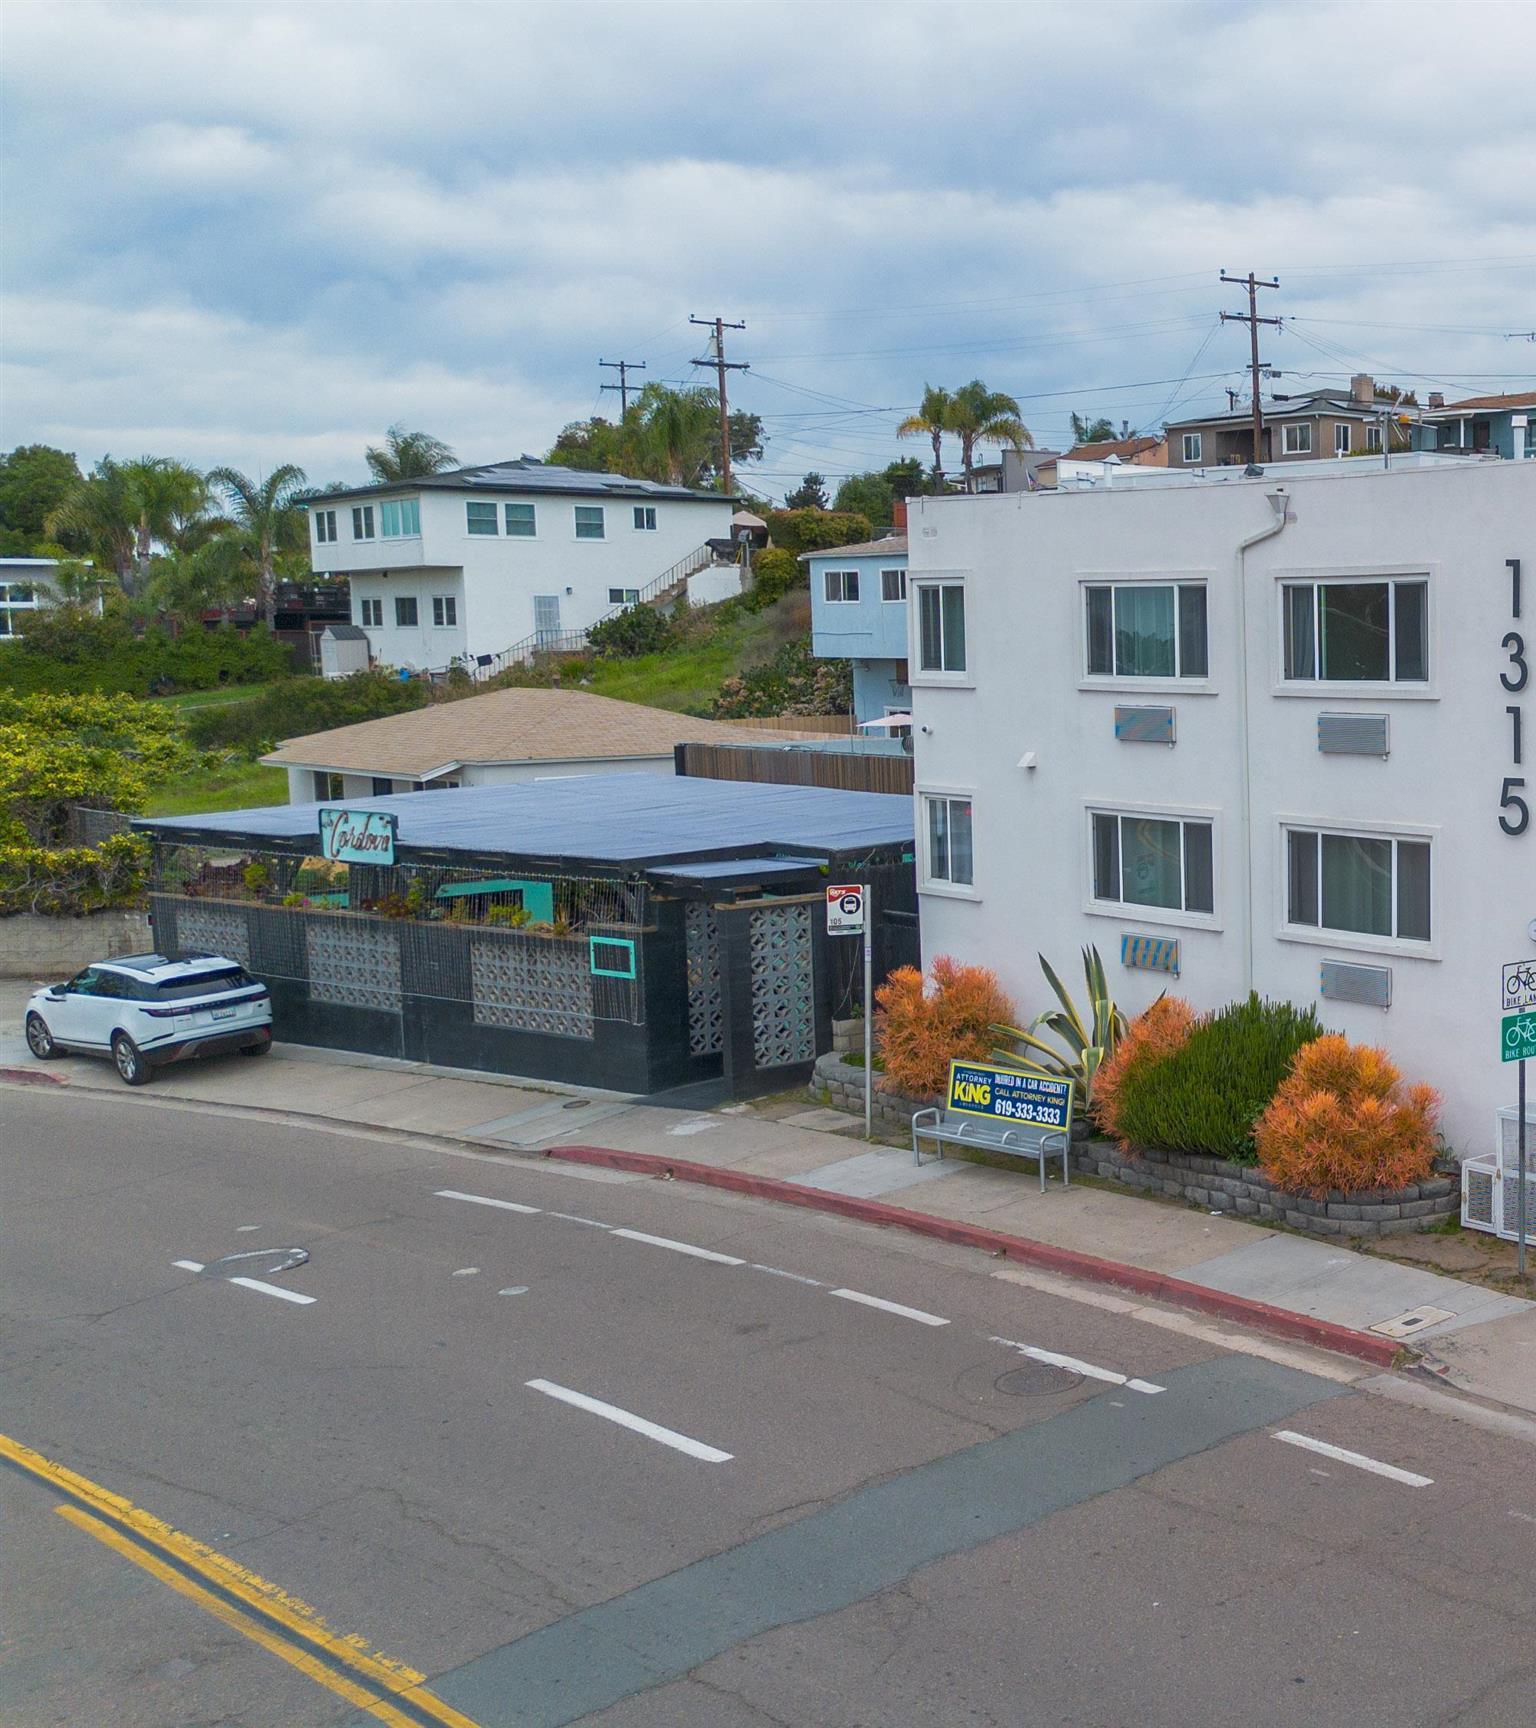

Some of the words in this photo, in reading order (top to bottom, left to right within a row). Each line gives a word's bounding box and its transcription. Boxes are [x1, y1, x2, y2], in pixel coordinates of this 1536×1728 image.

[1498, 559, 1529, 836] 1315
[331, 811, 390, 858] Cordova
[830, 917, 842, 925] 105
[1506, 996, 1521, 1007] BIKE
[1505, 1048, 1520, 1060] BIKE
[956, 1073, 992, 1085] ATTORNEY
[994, 1073, 1015, 1087] INJURED
[1015, 1077, 1022, 1088] IN
[1027, 1079, 1038, 1090] CAR
[994, 1087, 1010, 1097] CALL
[1011, 1090, 1046, 1102] ATTORNEY
[994, 1099, 1061, 1125] 619-333-3333
